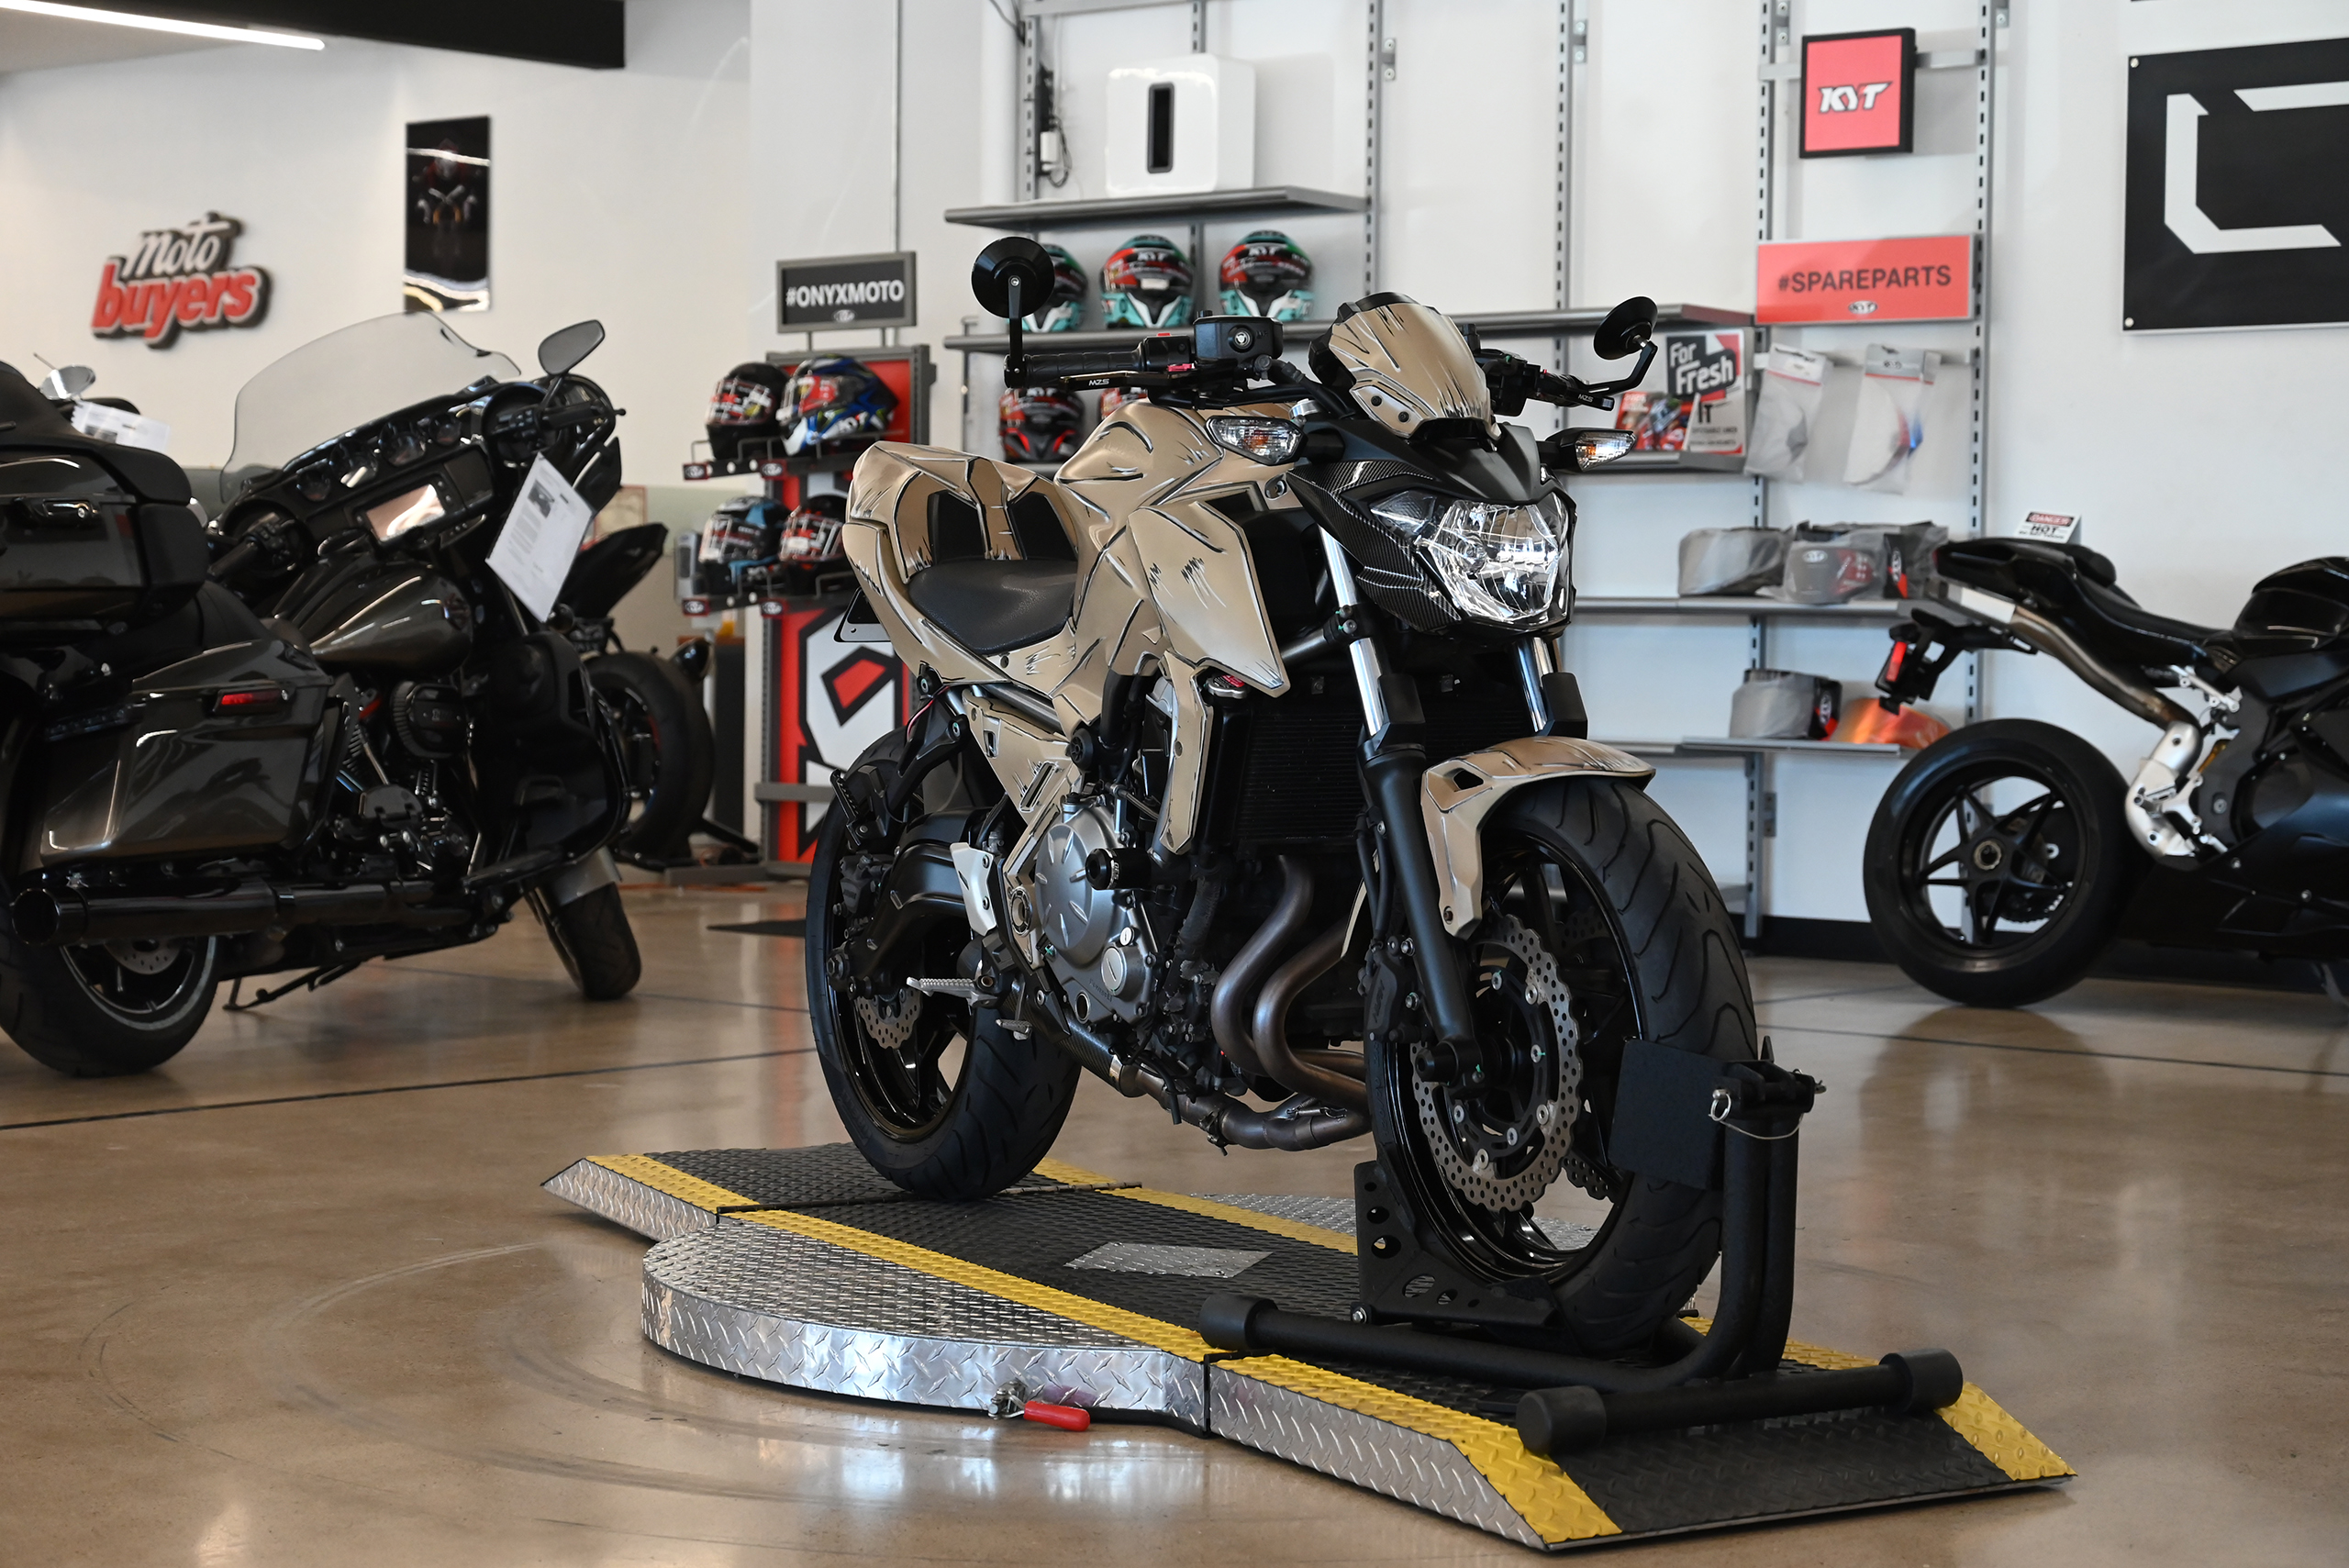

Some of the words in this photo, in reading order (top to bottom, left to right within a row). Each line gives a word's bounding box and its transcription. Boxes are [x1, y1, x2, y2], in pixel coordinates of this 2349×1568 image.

[1818, 81, 1893, 114] KYT
[122, 215, 230, 277] Moto
[785, 279, 906, 308] #ONYXMOTO
[1778, 265, 1952, 294] #SPAREPARTS
[92, 261, 261, 341] buyers
[1670, 341, 1697, 368] For
[1088, 378, 1109, 386] MZS
[1675, 355, 1733, 395] Fresh
[1578, 394, 1594, 403] MZS
